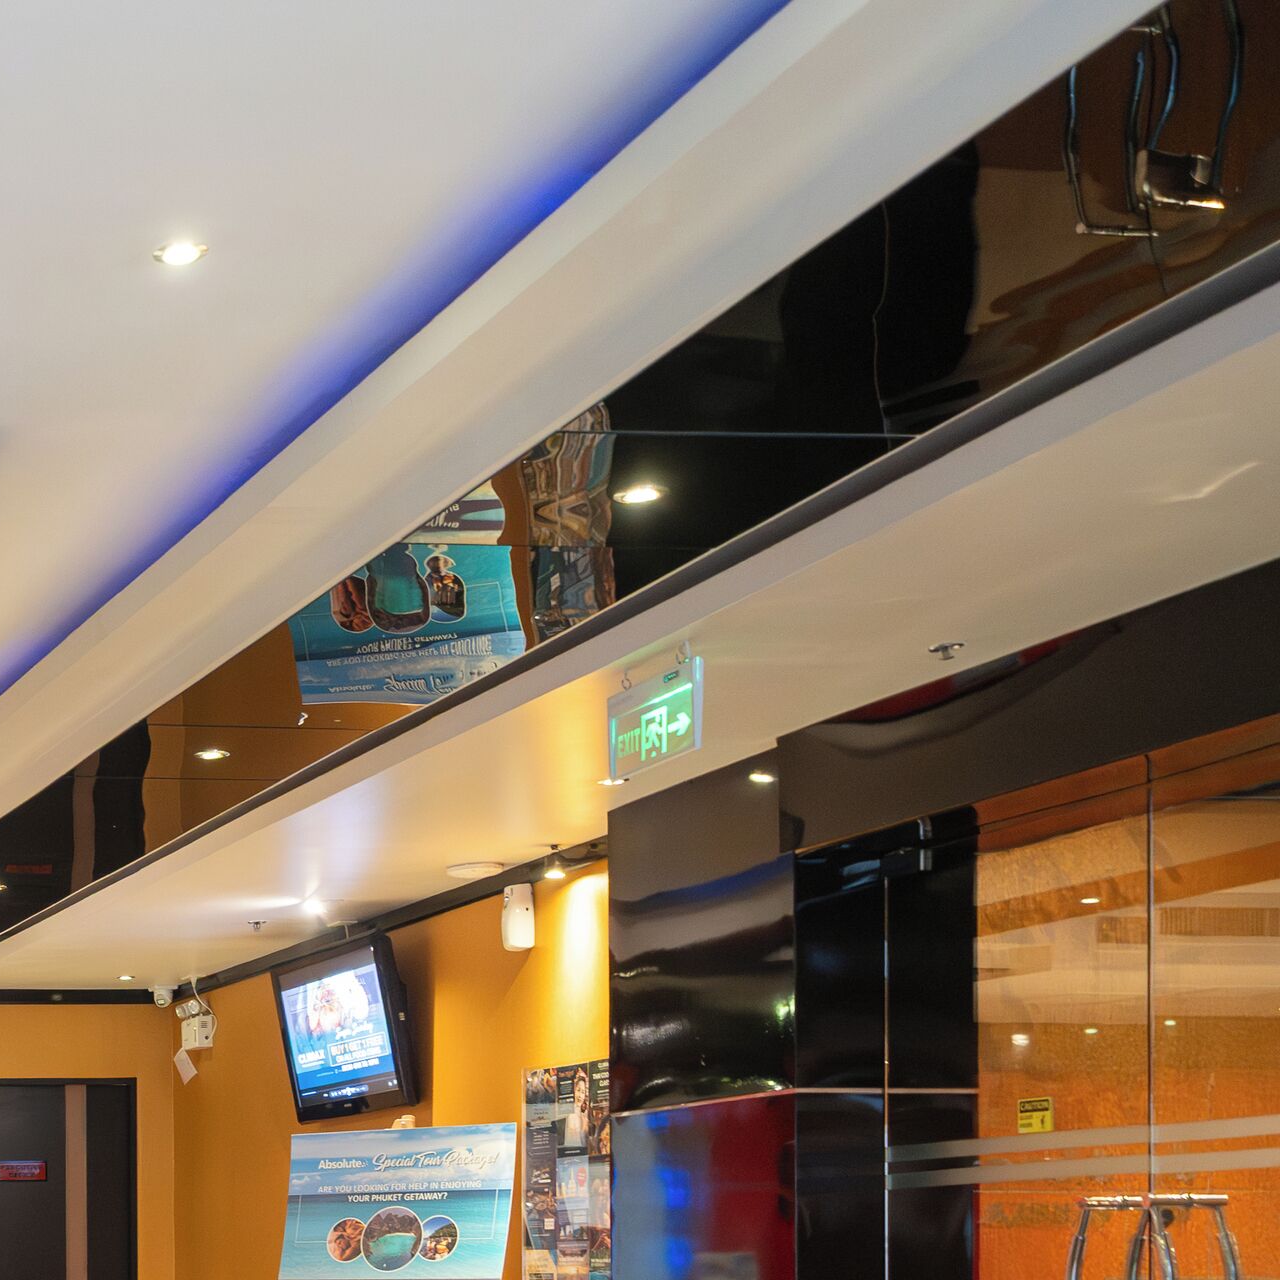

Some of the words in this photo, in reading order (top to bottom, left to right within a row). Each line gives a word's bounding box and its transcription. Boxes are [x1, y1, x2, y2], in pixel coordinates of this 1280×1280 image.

[617, 727, 640, 759] EXIT
[318, 1160, 362, 1170] Absolute
[372, 1153, 417, 1171] Special
[318, 1185, 333, 1193] ARE
[335, 1184, 352, 1193] YOU
[353, 1184, 389, 1193] LOOKING
[391, 1183, 407, 1191] FOR
[408, 1182, 428, 1190] HELP
[430, 1181, 439, 1189] IN
[440, 1180, 482, 1189] ENJOYING
[347, 1194, 369, 1203] YOUR
[370, 1193, 402, 1202] PHUKET
[403, 1192, 448, 1201] GETAWAY?
